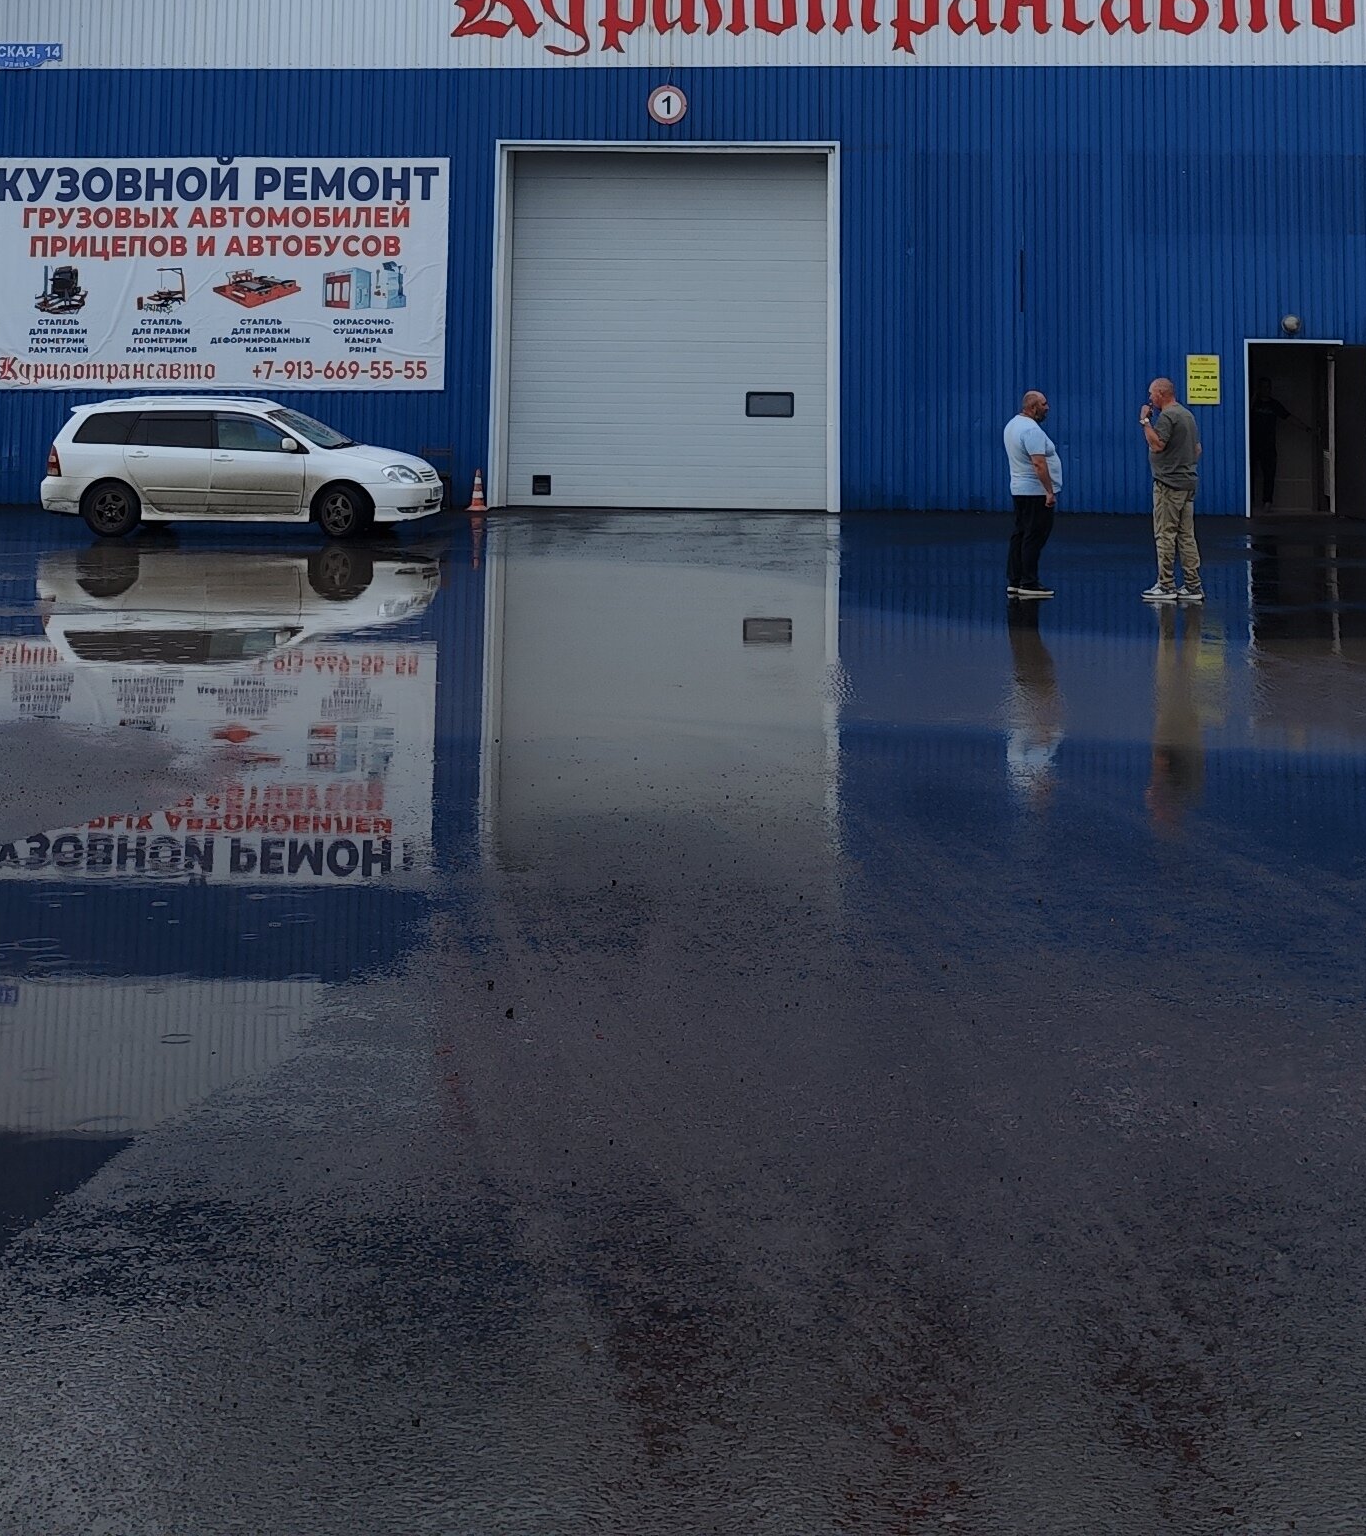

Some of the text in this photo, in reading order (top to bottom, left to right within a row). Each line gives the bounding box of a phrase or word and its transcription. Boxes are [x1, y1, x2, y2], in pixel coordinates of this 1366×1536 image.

[44, 46, 60, 57] 14
[661, 95, 671, 115] 1
[254, 166, 440, 201] РЕМОНТ
[23, 199, 410, 229] ГРУЗОВЫХ АВТОМОБИЛЕЙ
[29, 235, 401, 261] ПРИЦЕПОВ И АВТОБУСОВ
[49, 344, 89, 353] ТЯГАЧЕЙ
[147, 346, 197, 354] ПРИЦЕПОВ
[252, 360, 428, 380] +7-913-669-55-55
